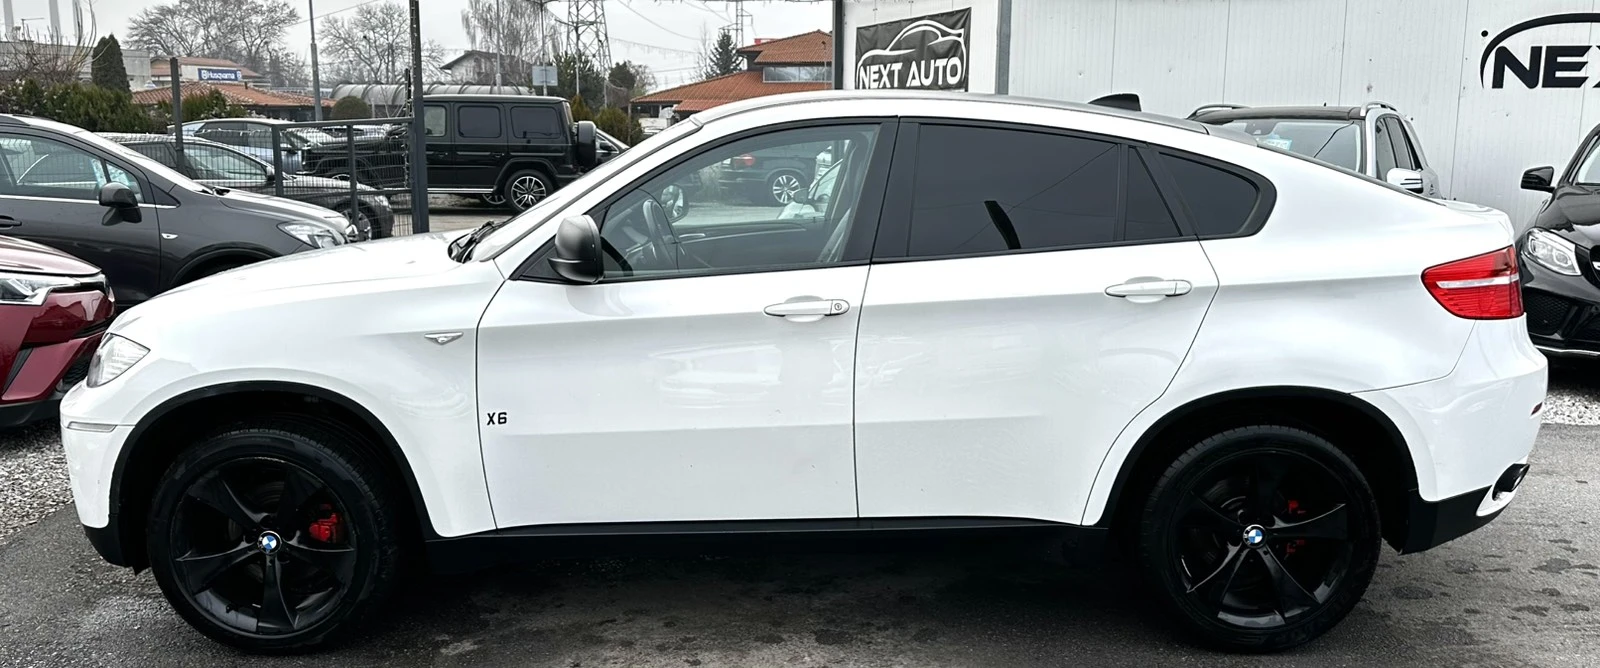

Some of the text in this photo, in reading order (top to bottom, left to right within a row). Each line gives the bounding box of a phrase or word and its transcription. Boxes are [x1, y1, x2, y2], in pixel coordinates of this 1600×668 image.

[860, 57, 962, 89] NEXT AUTO
[1492, 45, 1600, 89] NE
[486, 411, 508, 426] X6
